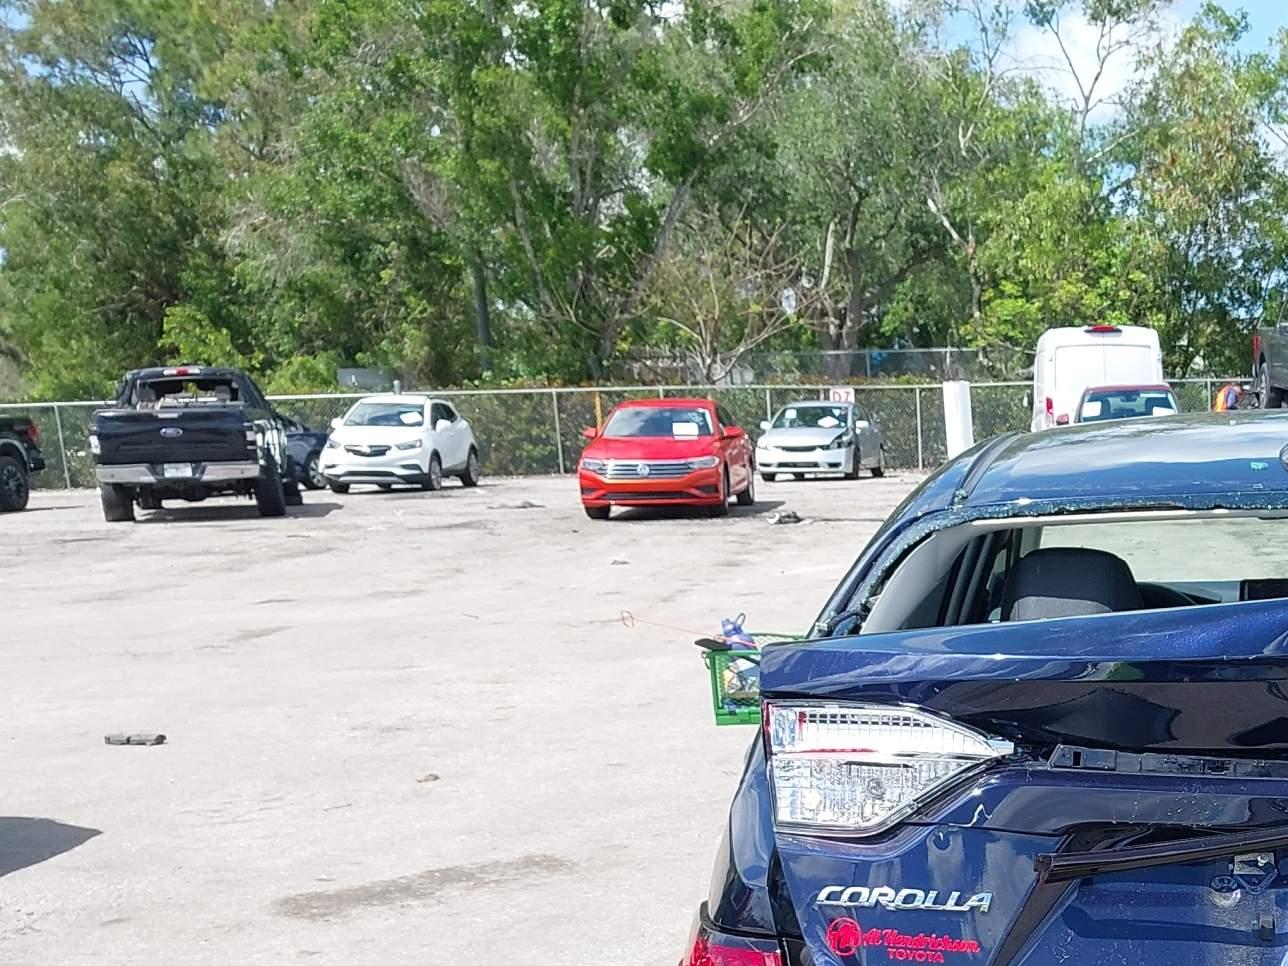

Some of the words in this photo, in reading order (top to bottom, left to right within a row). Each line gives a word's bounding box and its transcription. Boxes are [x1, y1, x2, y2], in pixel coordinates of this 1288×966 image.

[815, 884, 994, 913] COROLLA
[863, 928, 882, 946] Al
[882, 928, 981, 953] Hendrickson
[887, 947, 945, 963] TOYOTA
